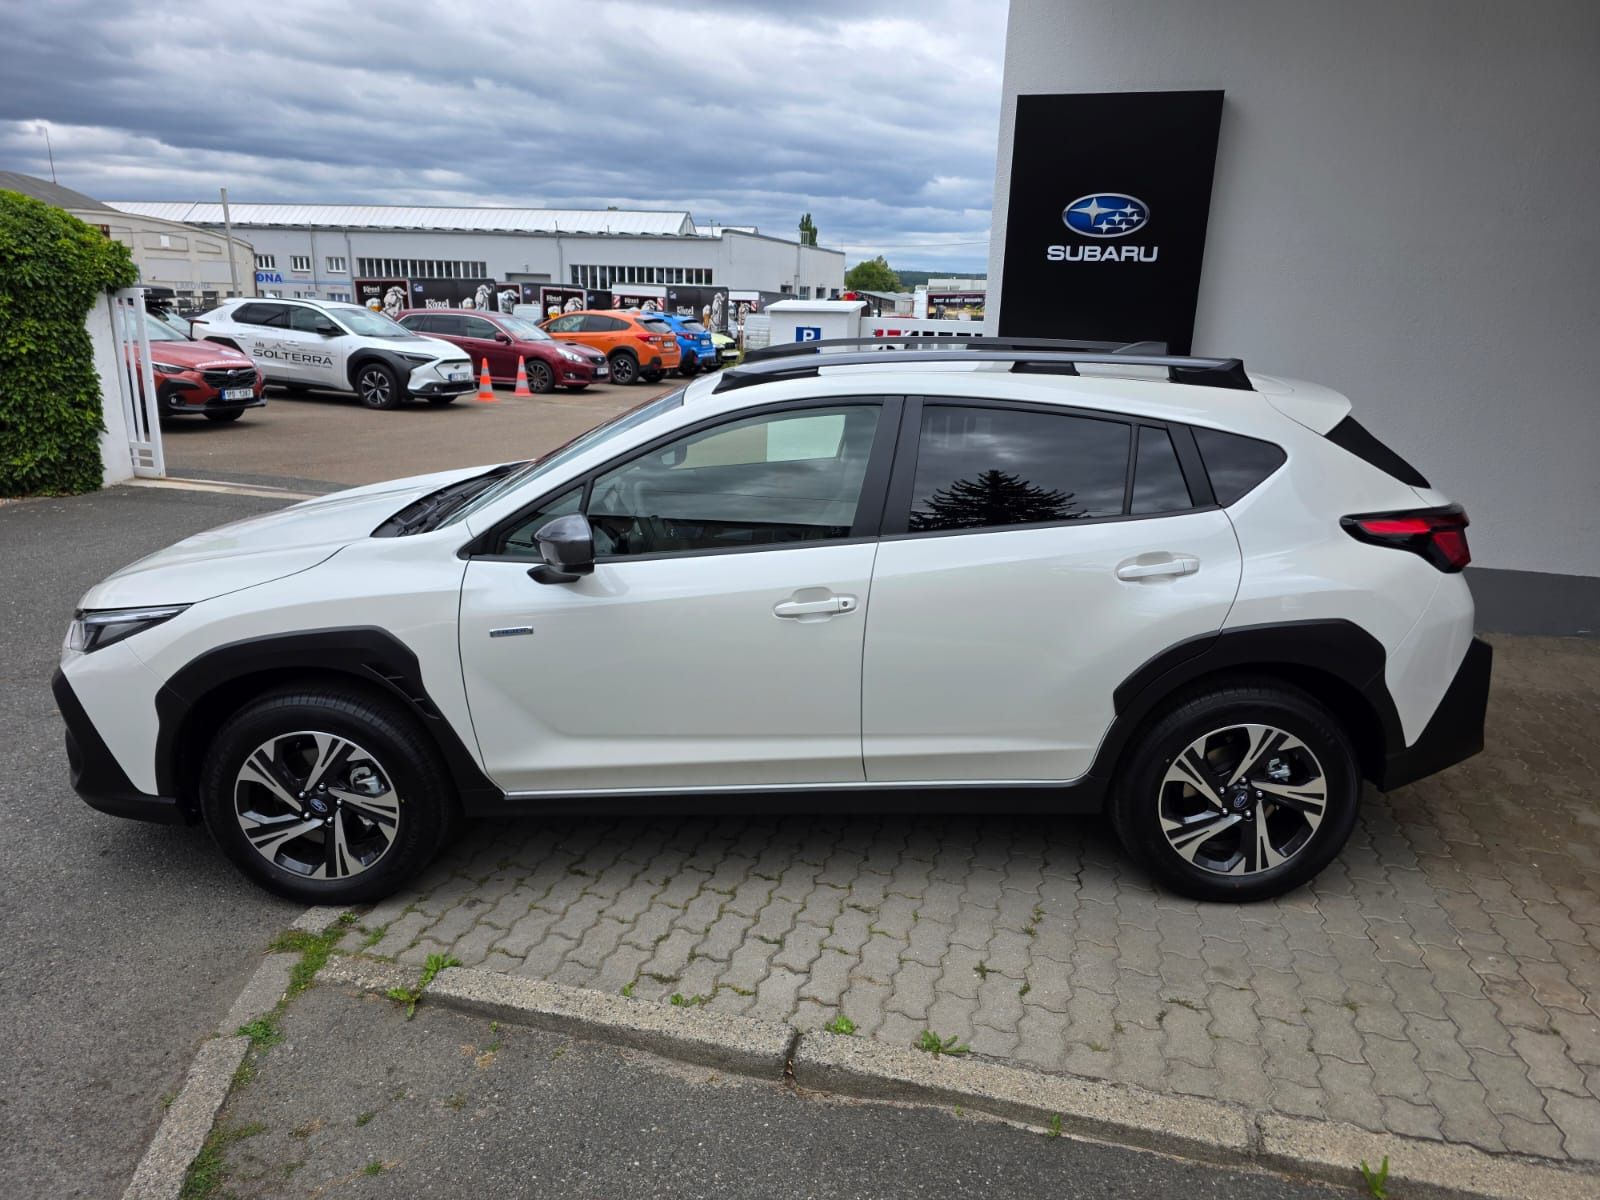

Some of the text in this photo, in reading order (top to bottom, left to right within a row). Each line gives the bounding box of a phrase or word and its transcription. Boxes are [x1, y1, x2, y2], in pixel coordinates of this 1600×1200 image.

[1047, 245, 1159, 262] SUBARU
[803, 329, 815, 342] P
[252, 348, 334, 366] SOLTERRA
